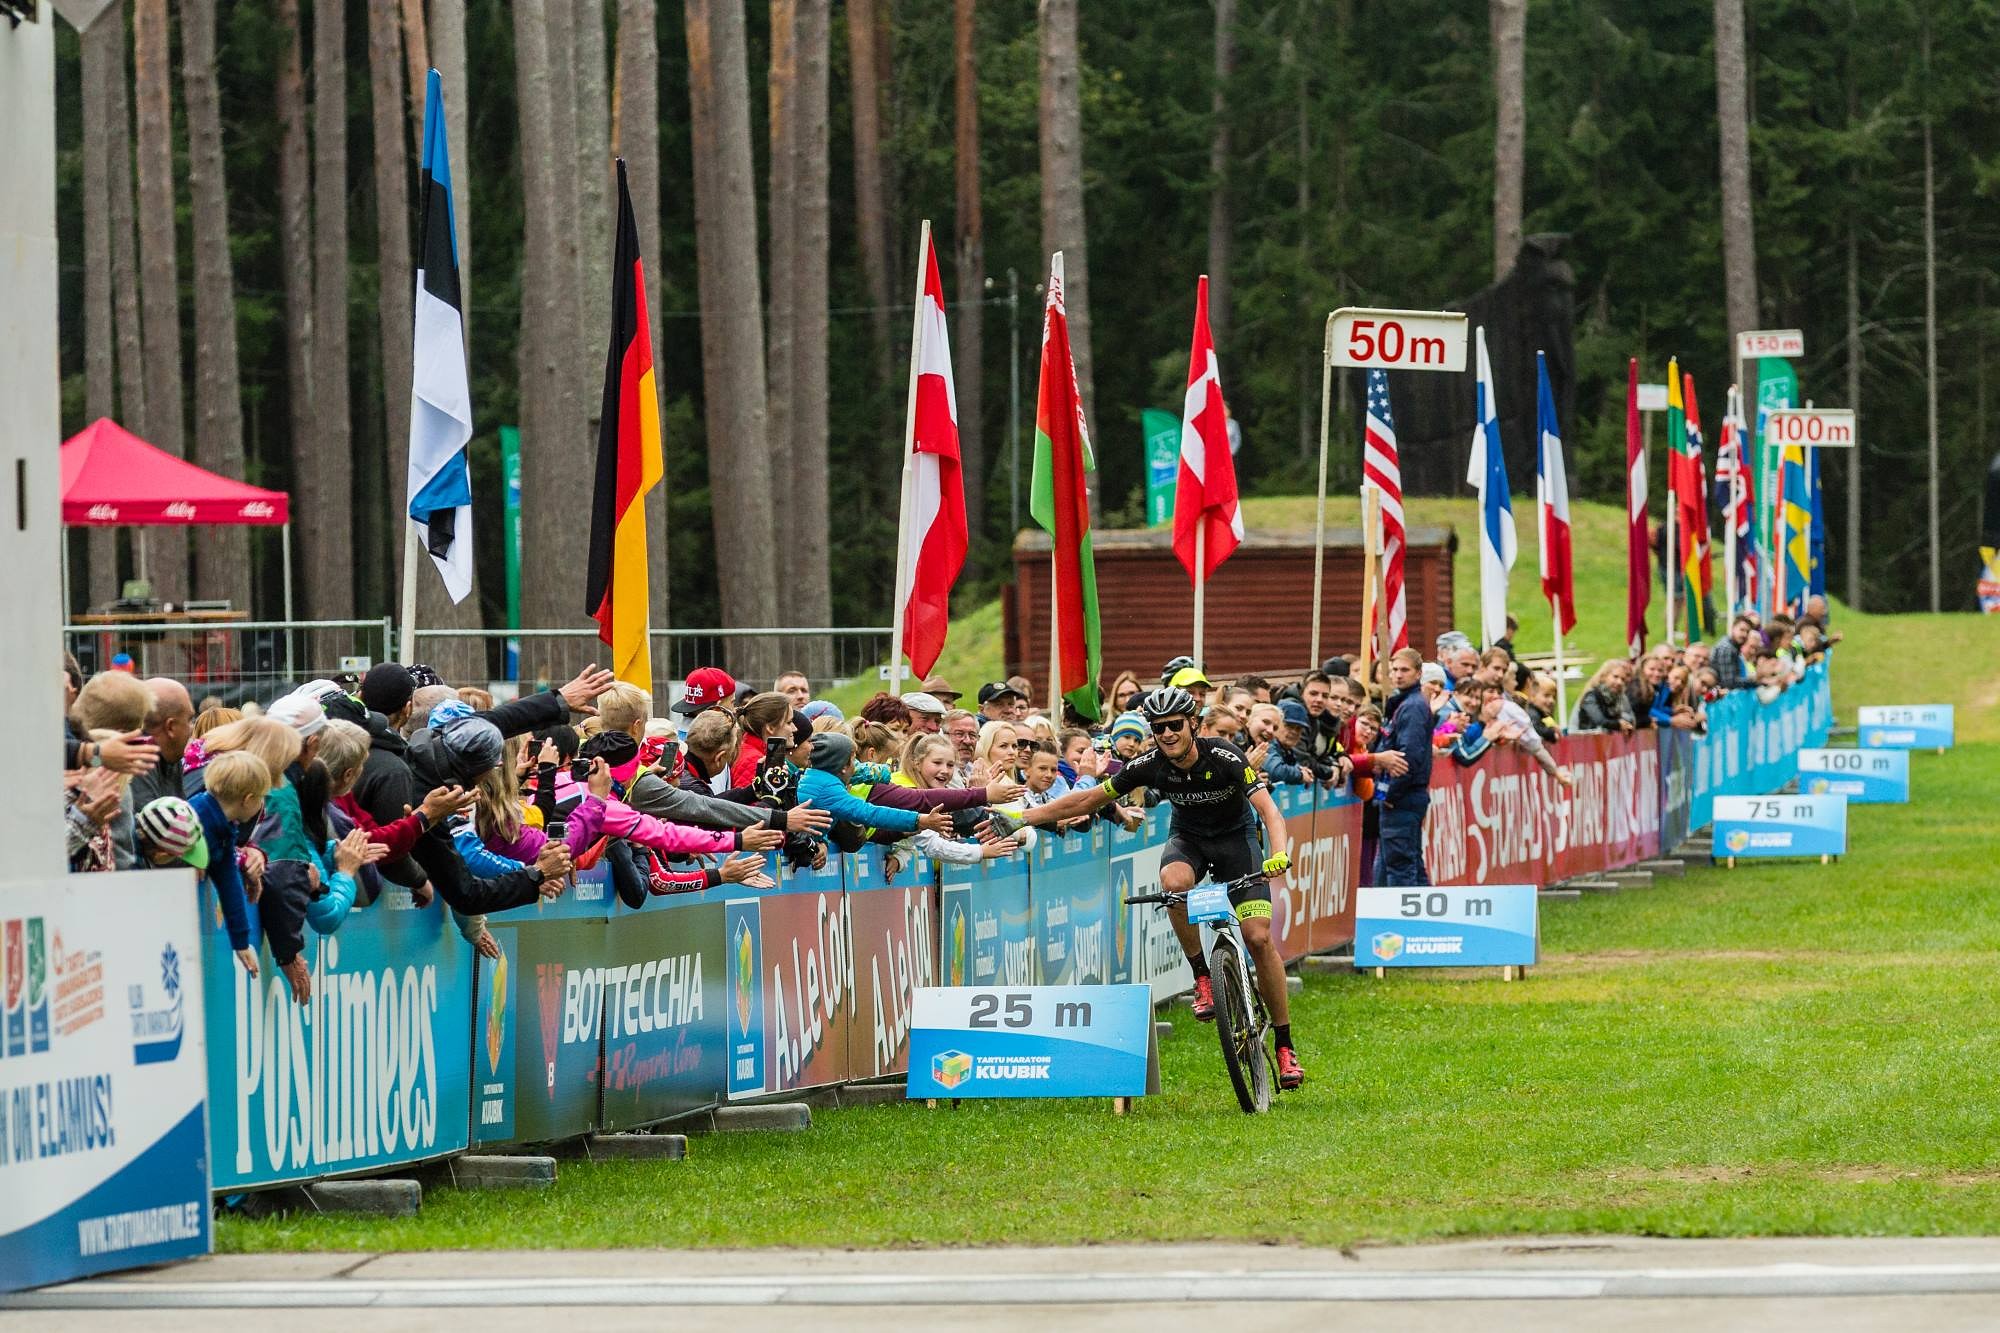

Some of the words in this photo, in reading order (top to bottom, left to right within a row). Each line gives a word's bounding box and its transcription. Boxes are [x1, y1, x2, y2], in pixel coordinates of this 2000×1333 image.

[1348, 320, 1445, 364] 50m
[1878, 710, 1914, 725] 125
[1921, 711, 1937, 722] m
[1126, 748, 1159, 771] FELT
[1211, 747, 1242, 763] FELT
[1819, 753, 1863, 771] 100
[1872, 756, 1890, 770] m
[1747, 801, 1781, 819] 75
[1793, 803, 1814, 818] m
[1400, 892, 1448, 917] 50
[1464, 898, 1492, 916] m
[1405, 942, 1463, 954] KUUBIK
[563, 952, 704, 1044] BOTTECCHIA
[968, 994, 1033, 1028] 25
[1055, 1001, 1092, 1027] m
[233, 936, 437, 1174] Postimees
[976, 1056, 1006, 1064] TARTU
[976, 1065, 1050, 1079] KUUBIK
[36, 1073, 115, 1158] ELAMUS!
